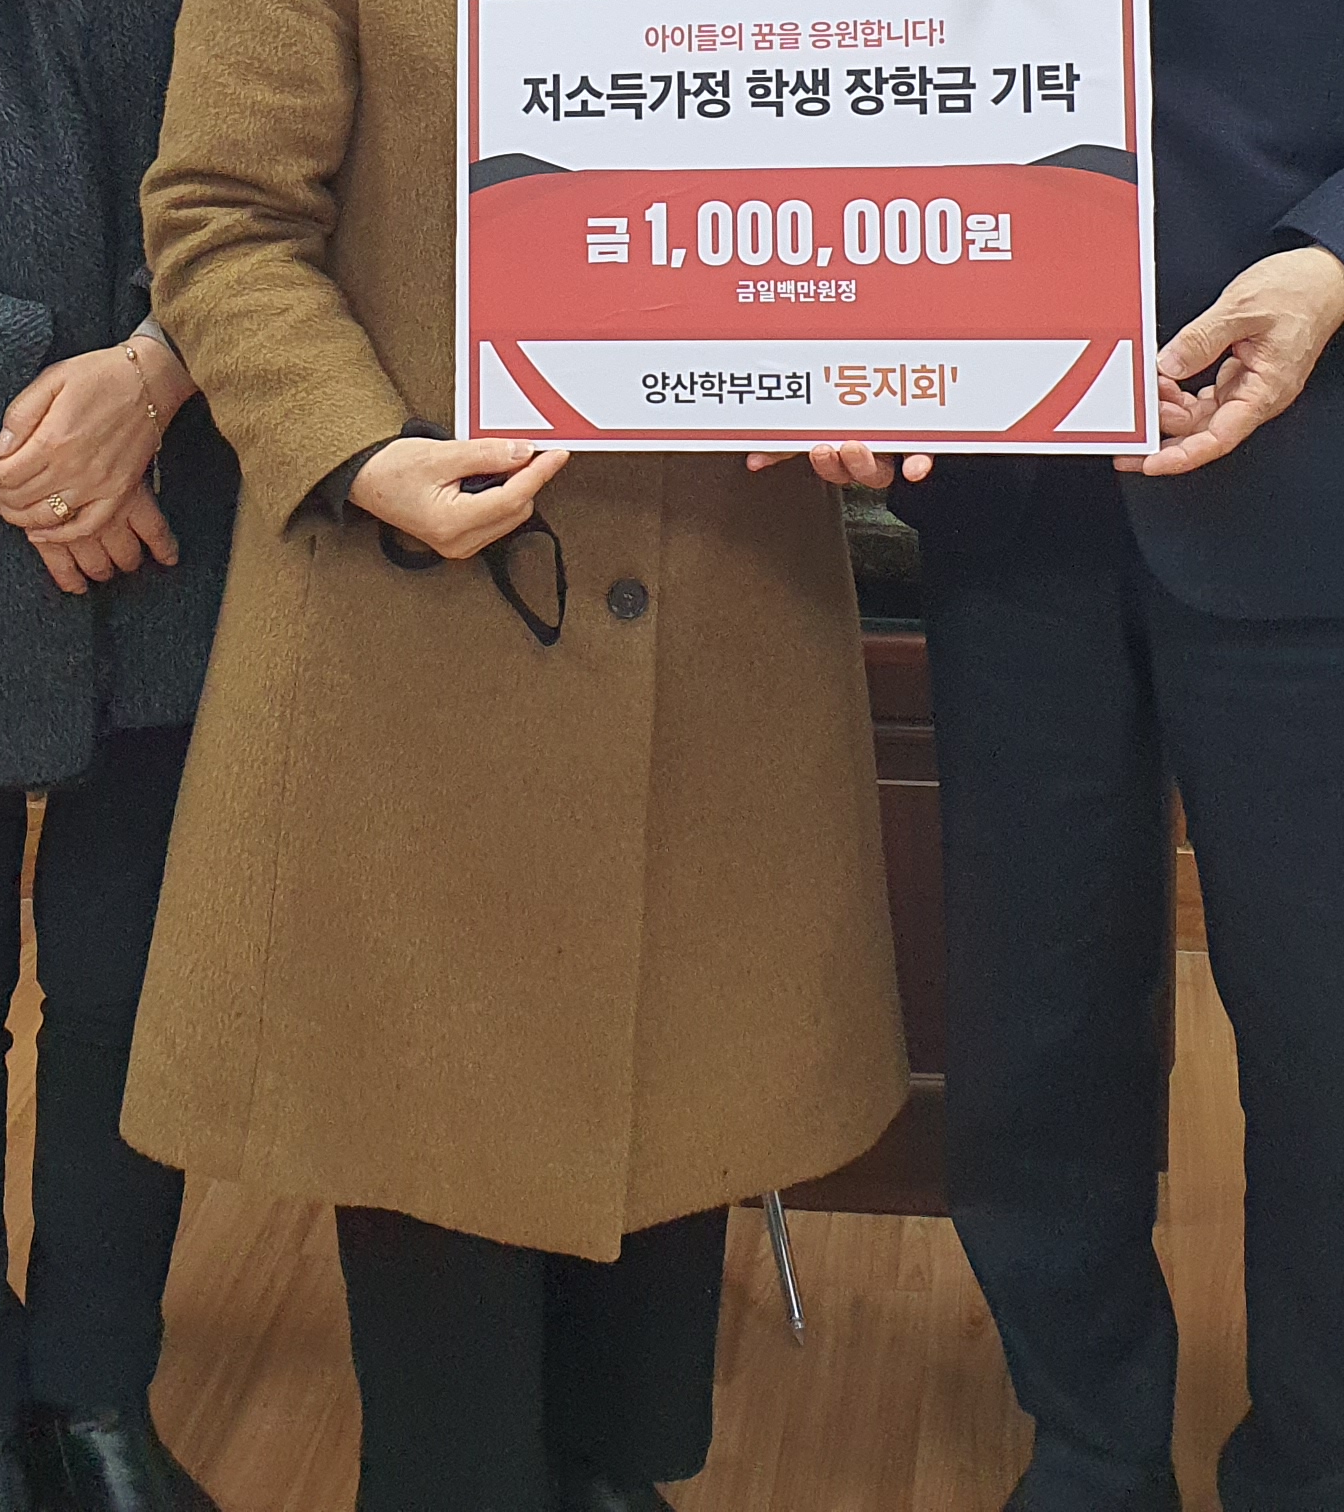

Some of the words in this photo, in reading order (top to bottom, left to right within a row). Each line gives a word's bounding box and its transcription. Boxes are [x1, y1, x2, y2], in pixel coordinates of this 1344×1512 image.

[643, 24, 745, 53] 아이들의
[751, 21, 802, 52] 꿈을
[807, 17, 946, 50] 응원합니다!
[522, 68, 730, 122] 저소득가정
[746, 67, 832, 116] 학생
[845, 64, 977, 115] 장학금
[990, 62, 1080, 114] 기탁
[586, 216, 629, 264] 금
[642, 198, 1013, 269] 1,000,000원
[736, 278, 857, 303] 금일백만원정
[641, 370, 812, 405] 양산학부모회
[823, 363, 958, 407] '둥지회'
